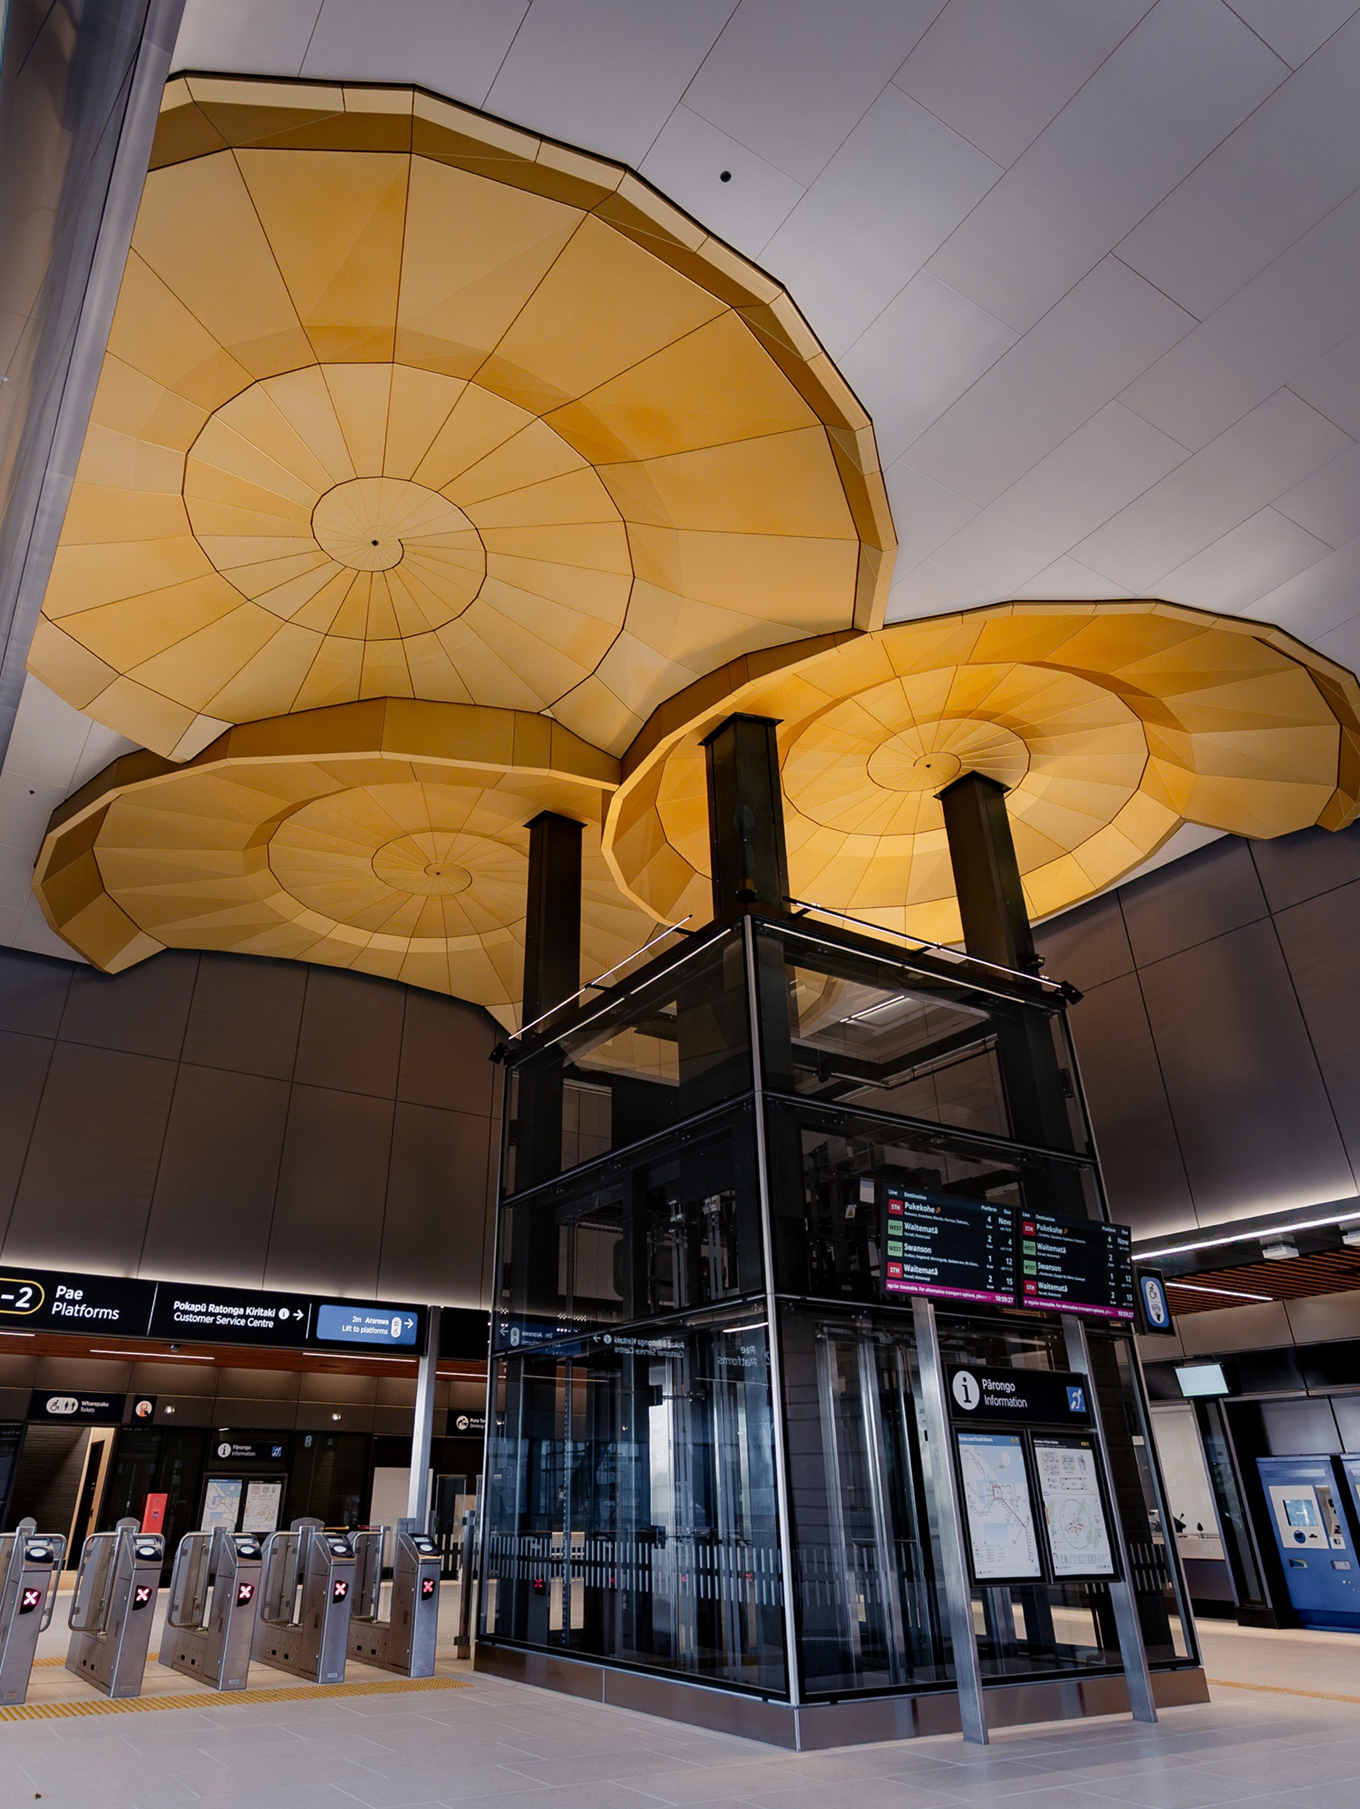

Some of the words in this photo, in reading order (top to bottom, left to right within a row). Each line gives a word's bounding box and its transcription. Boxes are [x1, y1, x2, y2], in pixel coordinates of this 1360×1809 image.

[904, 1191, 927, 1201] Destination
[890, 1203, 901, 1211] STH
[904, 1201, 936, 1214] Pukekohe
[981, 1205, 998, 1213] Platform
[987, 1215, 992, 1223] 4
[998, 1216, 1012, 1226] Now
[1035, 1214, 1056, 1222] Destination
[889, 1224, 902, 1232] WEST
[1036, 1223, 1063, 1235] Pukekohe
[987, 1234, 992, 1243] 2
[1007, 1238, 1013, 1246] 4
[1107, 1235, 1112, 1243] 4
[1117, 1237, 1129, 1246] Now
[904, 1242, 932, 1254] Swanson
[1024, 1244, 1035, 1252] WEST
[988, 1254, 992, 1263] 1
[1005, 1257, 1013, 1266] 12
[1108, 1253, 1113, 1262] 2
[889, 1266, 901, 1274] STH
[1037, 1261, 1062, 1273] Swanson
[988, 1274, 993, 1283] 2
[1110, 1272, 1114, 1280] 1
[1125, 1274, 1132, 1283] 12
[1006, 1277, 1014, 1286] 15
[1026, 1283, 1036, 1291] STH
[54, 1284, 84, 1301] Pae
[1110, 1291, 1115, 1300] 2
[995, 1295, 1014, 1304] 10:59:27
[1126, 1293, 1133, 1302] 15
[51, 1301, 121, 1321] Platforms
[173, 1300, 207, 1313] Pokapū
[207, 1303, 245, 1317] Ratonga
[245, 1306, 277, 1318] Kiritaki
[1117, 1310, 1134, 1319] 10:59:27
[173, 1311, 215, 1324] Customer
[215, 1315, 246, 1327] Service
[246, 1317, 275, 1329] Centre
[351, 1315, 363, 1324] 2m
[364, 1316, 390, 1326] Ararewa
[341, 1324, 353, 1333] Lift
[353, 1325, 360, 1333] to
[360, 1327, 389, 1336] platforms
[982, 1378, 1016, 1394] Pārongo
[80, 1400, 110, 1409] Wharepaku
[983, 1394, 1028, 1408] Information
